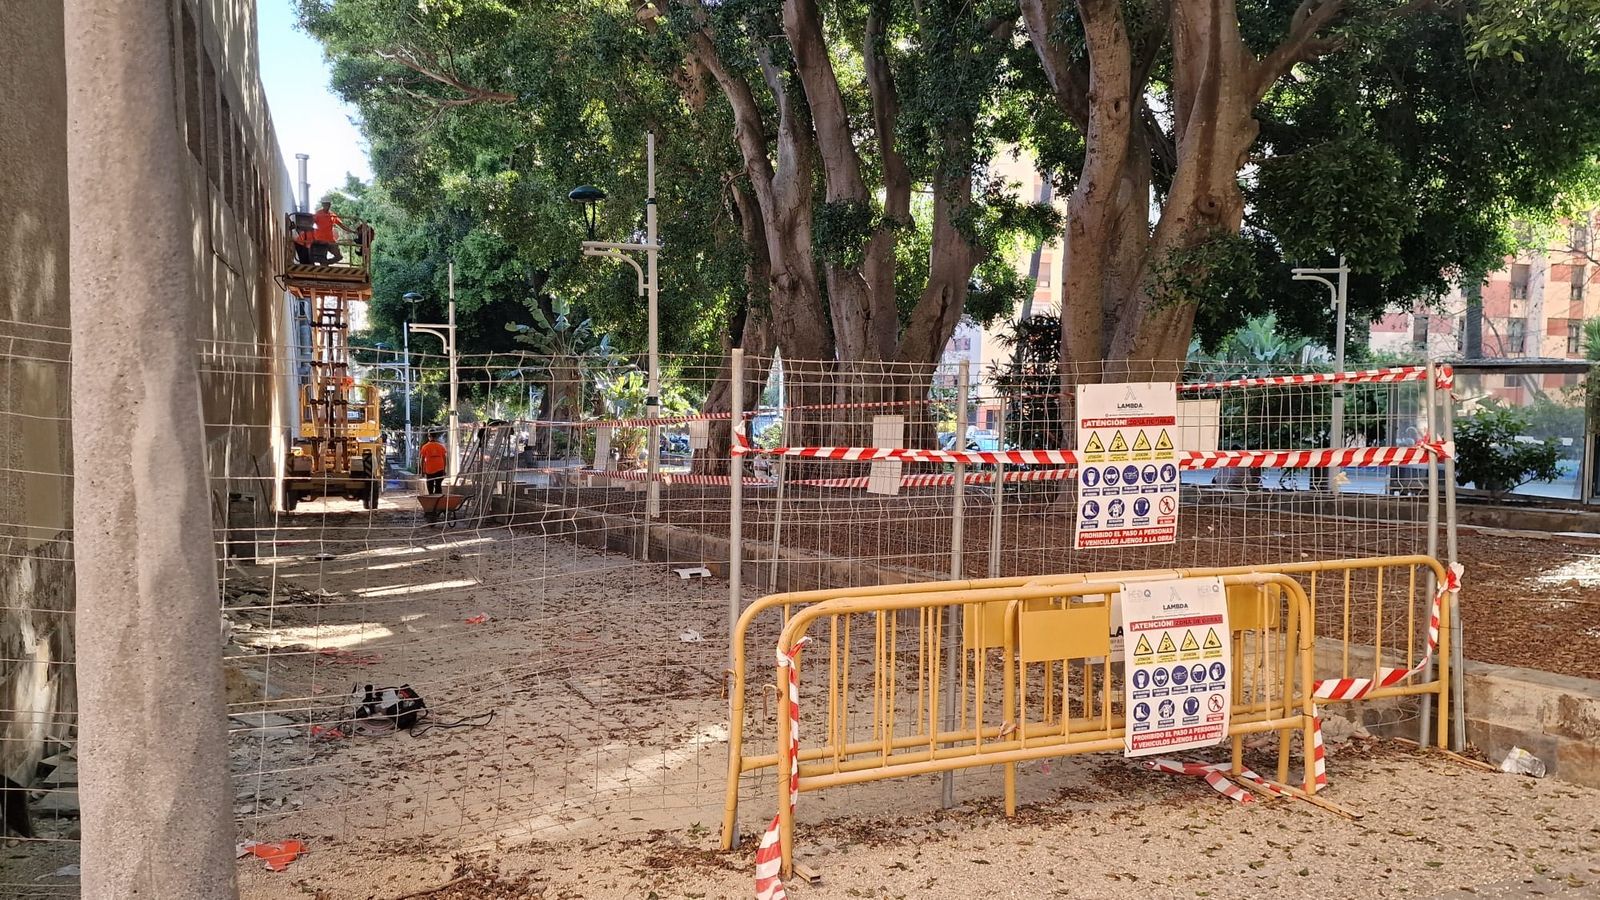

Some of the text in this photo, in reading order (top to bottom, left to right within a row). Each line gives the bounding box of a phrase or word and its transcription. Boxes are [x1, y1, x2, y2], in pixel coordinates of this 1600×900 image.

[1084, 419, 1127, 428] ¡ATENCIÓN!
[1080, 531, 1113, 539] PROHIBIDO
[1123, 529, 1138, 537] PASO
[1144, 527, 1173, 536] PERSONAS
[1132, 620, 1174, 631] ¡ATENCIÓN!
[1133, 732, 1165, 741] PROHIBIDO
[1173, 728, 1188, 737] PASO
[1193, 724, 1222, 734] PERSONAS
[1171, 735, 1192, 744] AJENOS
[1206, 731, 1222, 739] OBRA
